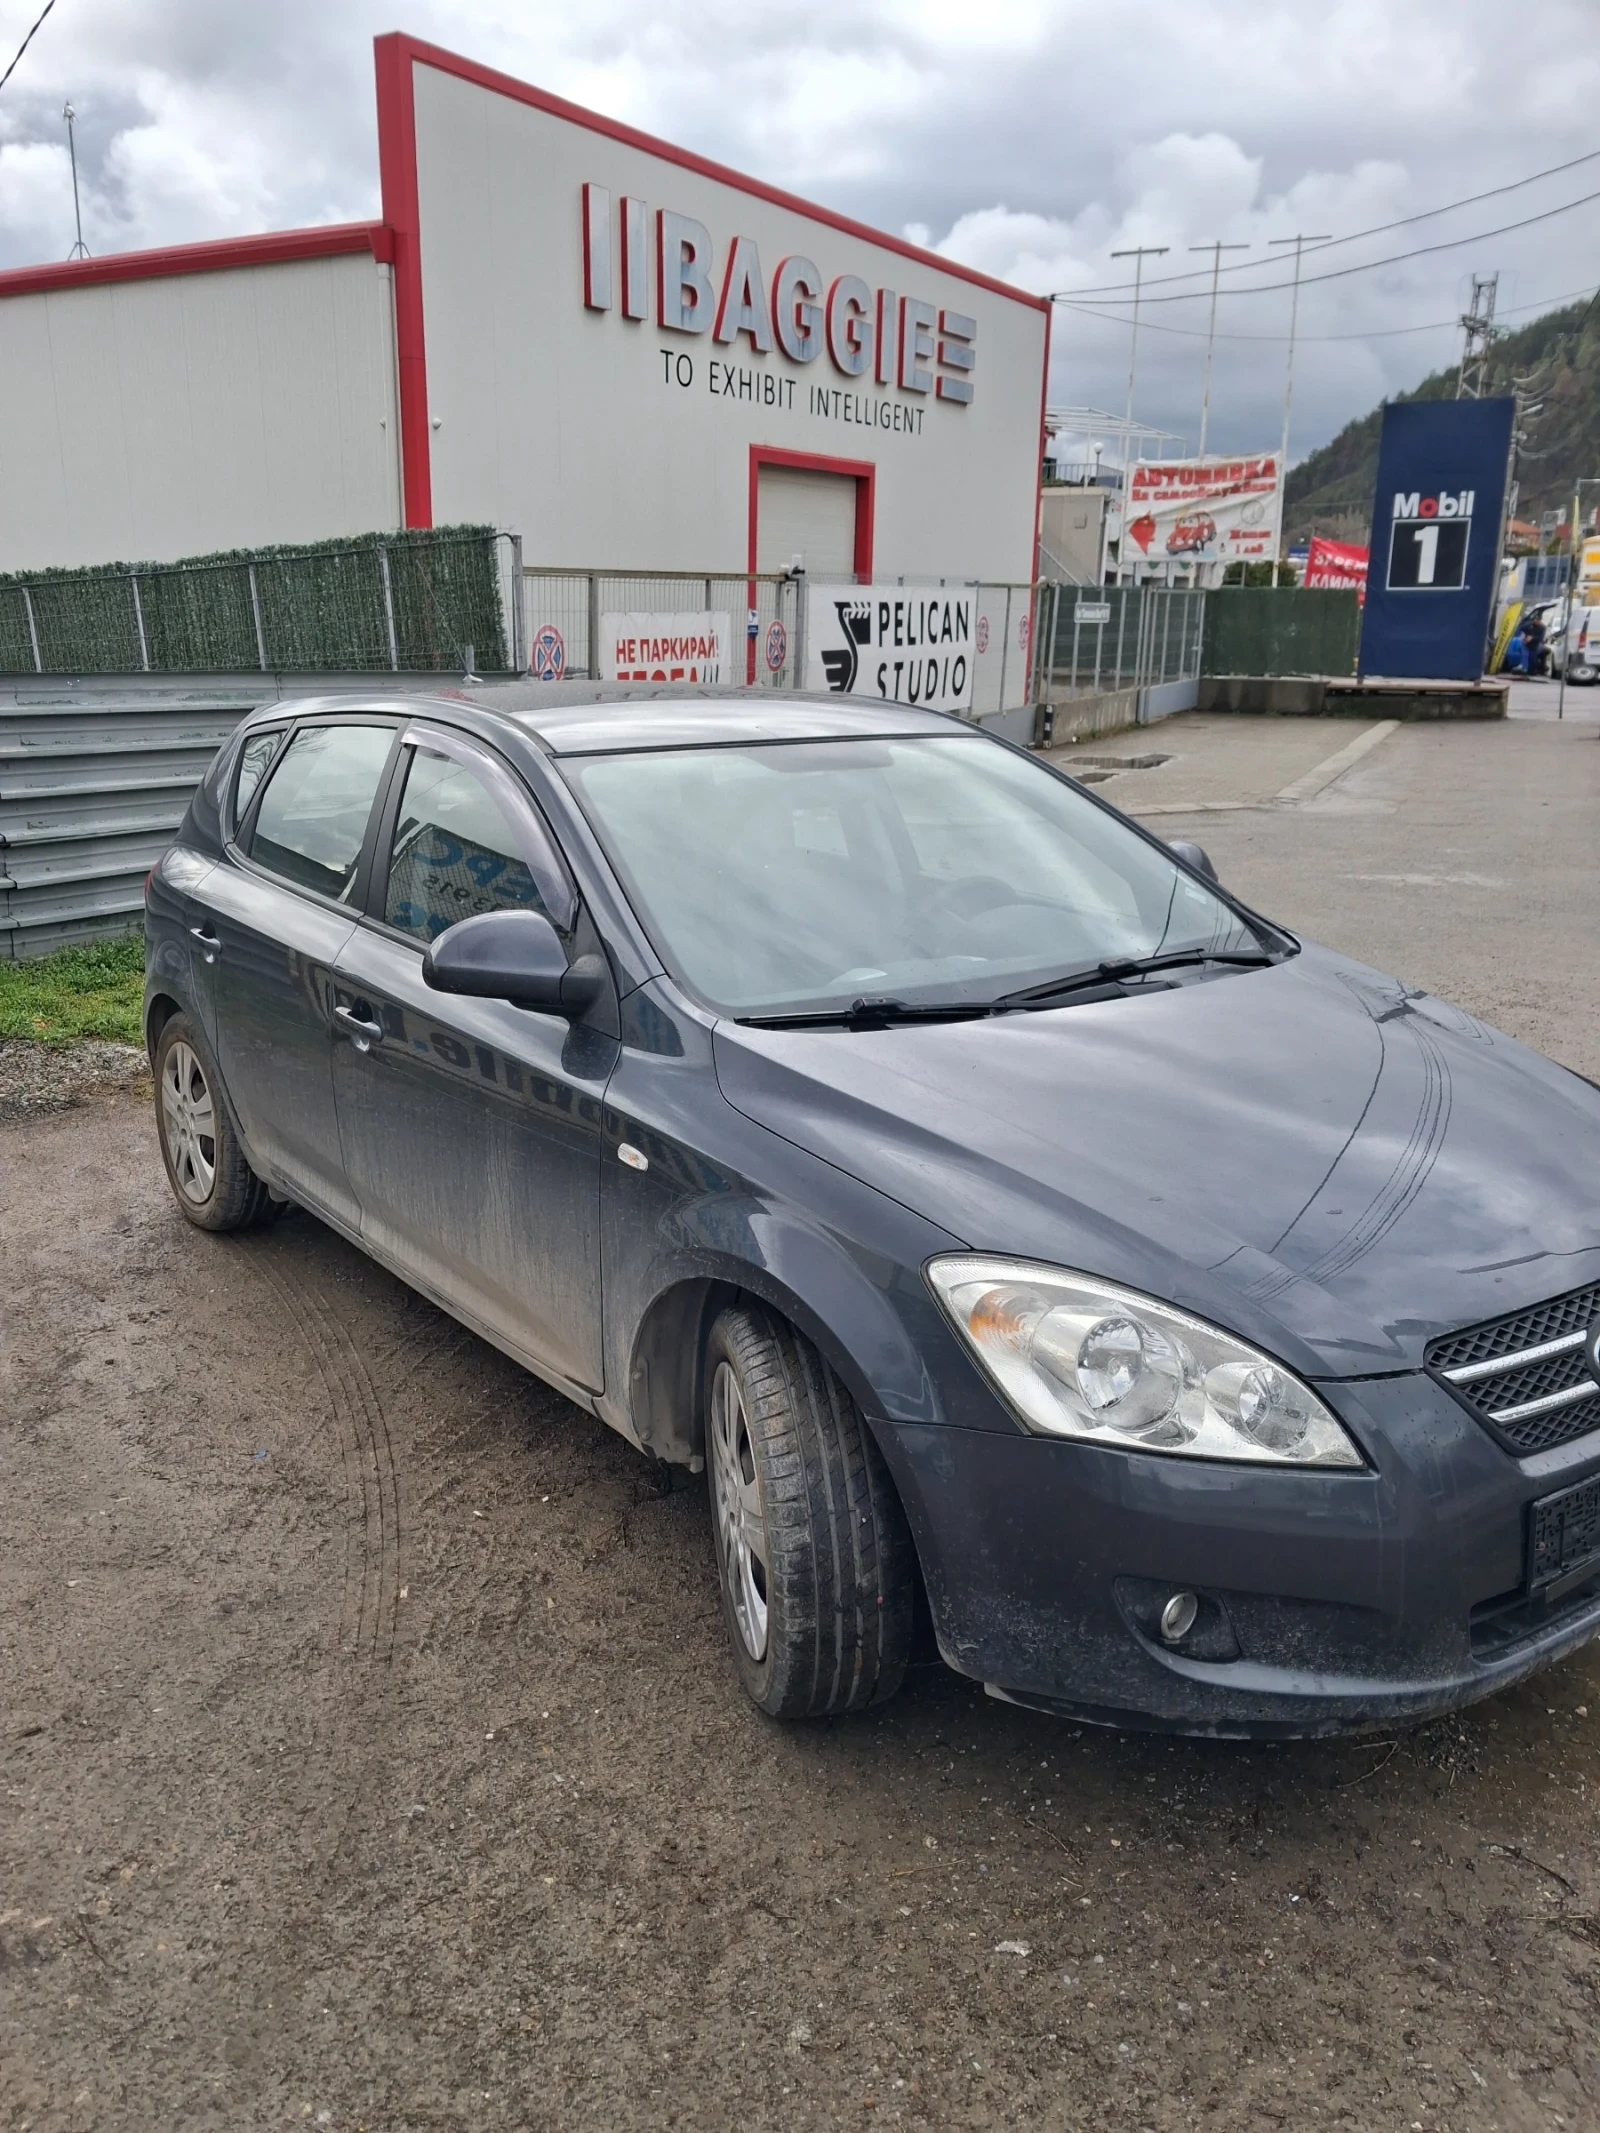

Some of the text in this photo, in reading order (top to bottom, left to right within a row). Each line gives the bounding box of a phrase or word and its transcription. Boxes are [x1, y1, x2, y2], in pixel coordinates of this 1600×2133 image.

[660, 349, 925, 435] TO EXHIBIT INTELLIGENT
[1132, 458, 1277, 487] АВТОМИВКА
[1393, 490, 1475, 518] Mobil
[1414, 525, 1439, 583] 1
[878, 601, 969, 648] PELICAN
[616, 634, 719, 664] НЕ ПАРКИРАЙ!
[877, 655, 966, 703] STUDIO
